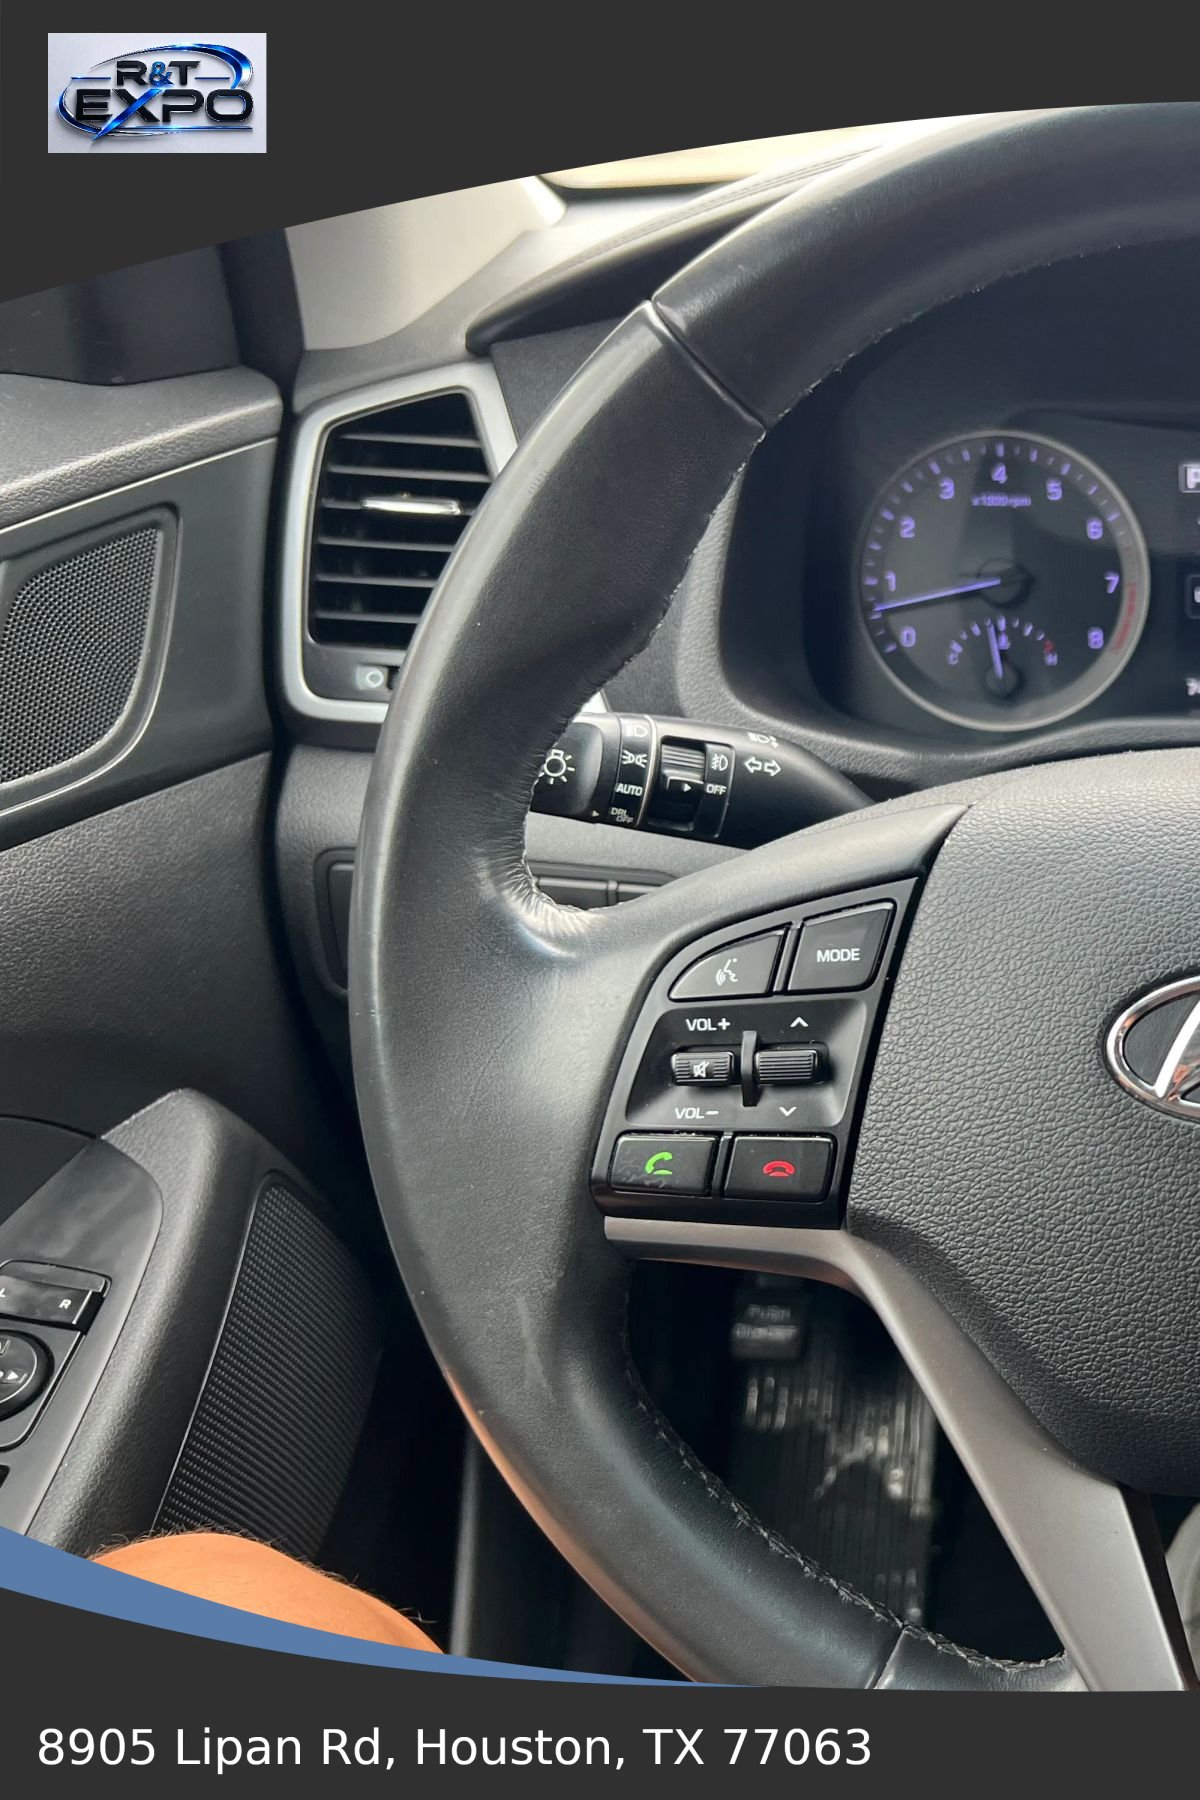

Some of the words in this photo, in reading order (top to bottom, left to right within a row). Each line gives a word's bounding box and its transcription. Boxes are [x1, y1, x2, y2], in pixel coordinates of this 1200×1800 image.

[991, 463, 1008, 484] 4
[939, 477, 956, 500] 3
[1046, 478, 1063, 500] 5
[900, 515, 916, 538] 2
[1086, 518, 1103, 540] 6
[884, 570, 896, 592] 1
[1105, 572, 1120, 594] 7
[900, 625, 917, 648] 0
[1086, 626, 1104, 649] 8
[616, 783, 643, 796] AUTO
[706, 784, 727, 795] OFF
[611, 807, 628, 818] DRL
[616, 815, 633, 824] OFF
[816, 948, 860, 963] MODE
[59, 1299, 72, 1310] R
